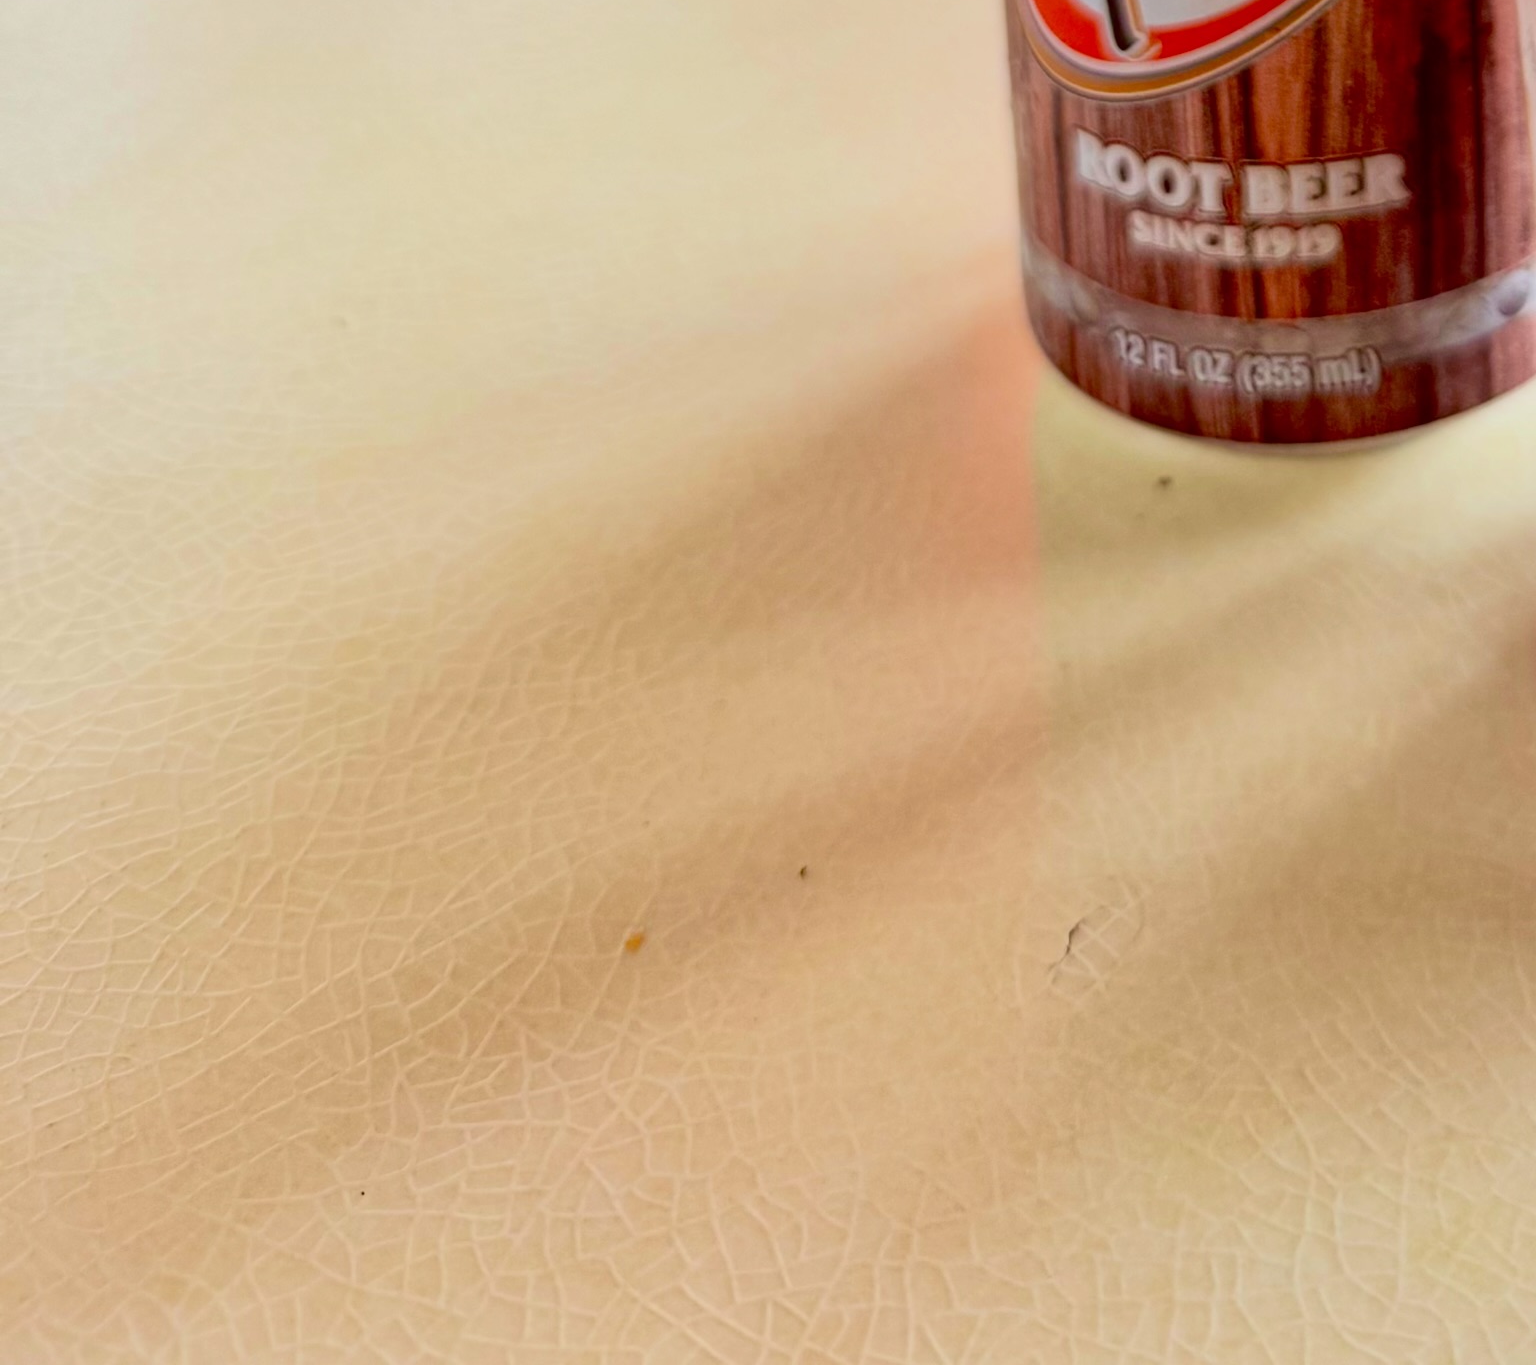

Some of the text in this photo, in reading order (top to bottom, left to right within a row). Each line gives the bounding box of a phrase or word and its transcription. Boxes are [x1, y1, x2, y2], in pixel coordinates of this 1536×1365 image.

[1076, 125, 1410, 214] ROOT BEER
[1129, 209, 1342, 259] SINCE 1919
[1111, 327, 1380, 395] 12 FL OZ (355 mL)
